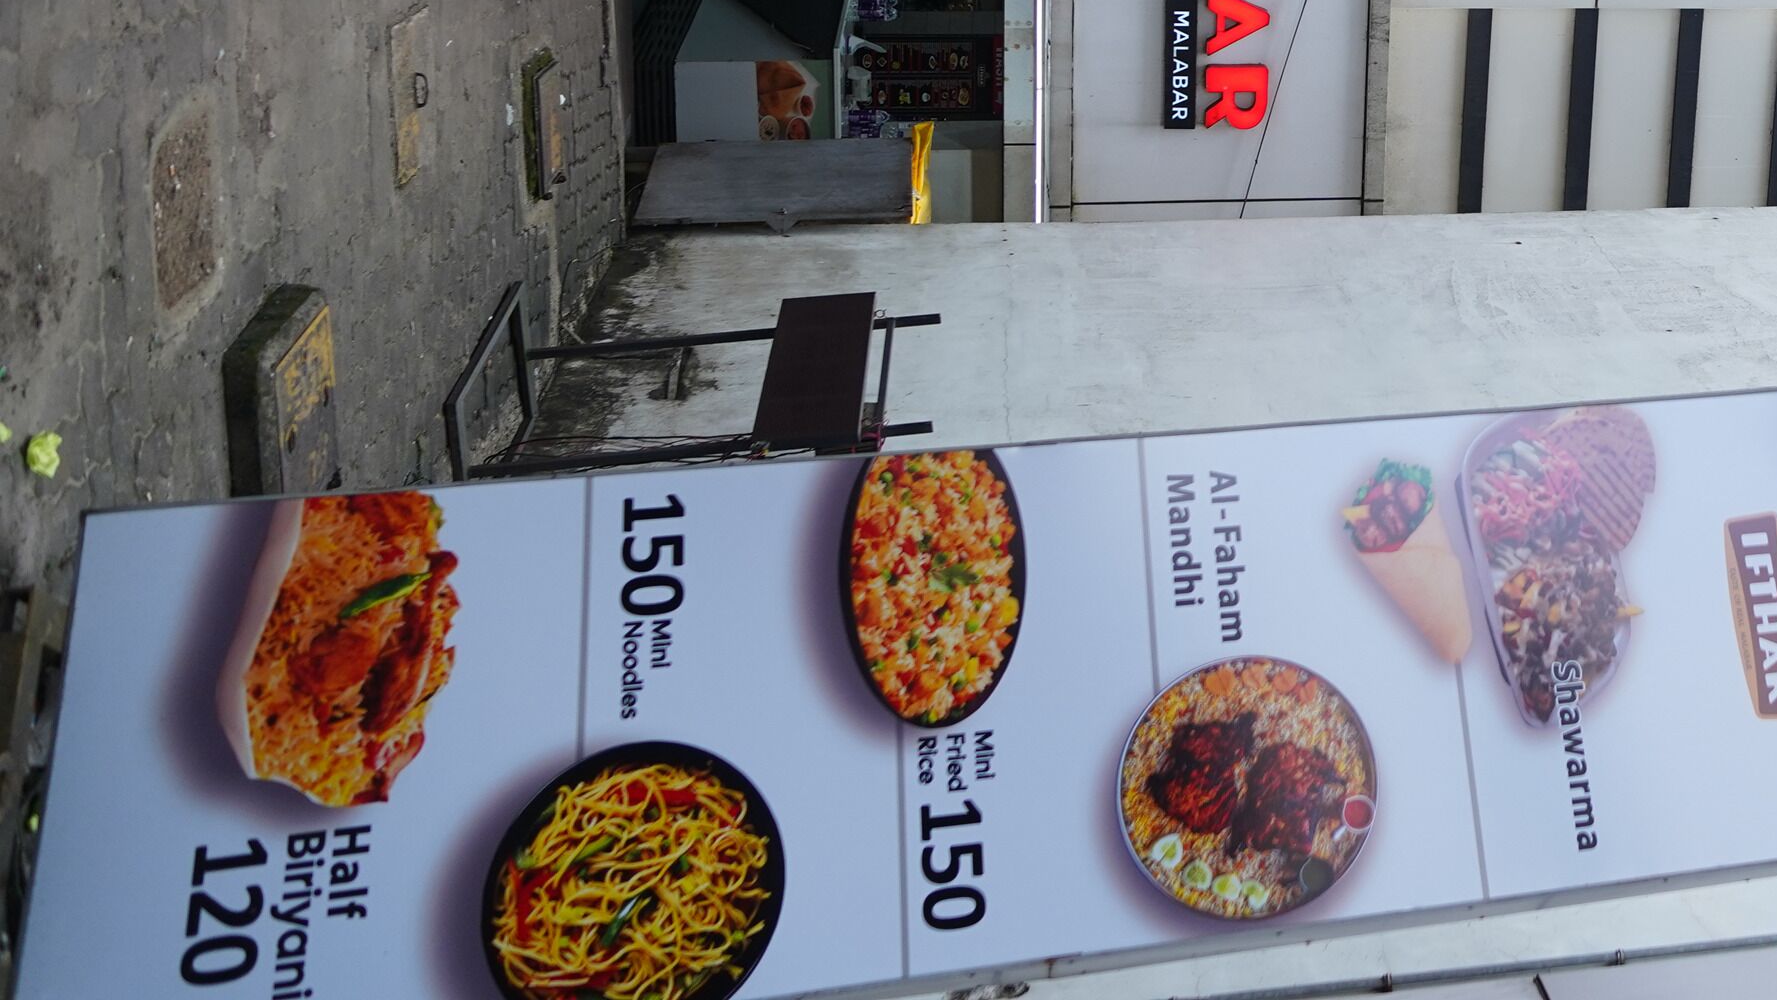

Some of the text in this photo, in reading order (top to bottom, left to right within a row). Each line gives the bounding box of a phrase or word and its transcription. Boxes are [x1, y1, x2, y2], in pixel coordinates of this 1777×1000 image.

[1171, 10, 1191, 121] MALABAR
[619, 493, 686, 617] 150
[1166, 474, 1204, 607] Mandhi
[1208, 470, 1246, 643] Al-Faham
[619, 620, 645, 720] Noodles
[649, 619, 672, 669] Mini
[917, 737, 938, 785] Rice
[945, 733, 968, 792] Fried
[973, 730, 995, 780] Mini
[1551, 659, 1601, 852] Shawarma
[180, 838, 268, 987] 120
[270, 829, 327, 1000] Biriyani
[327, 824, 372, 919] Half
[920, 800, 987, 932] 150
